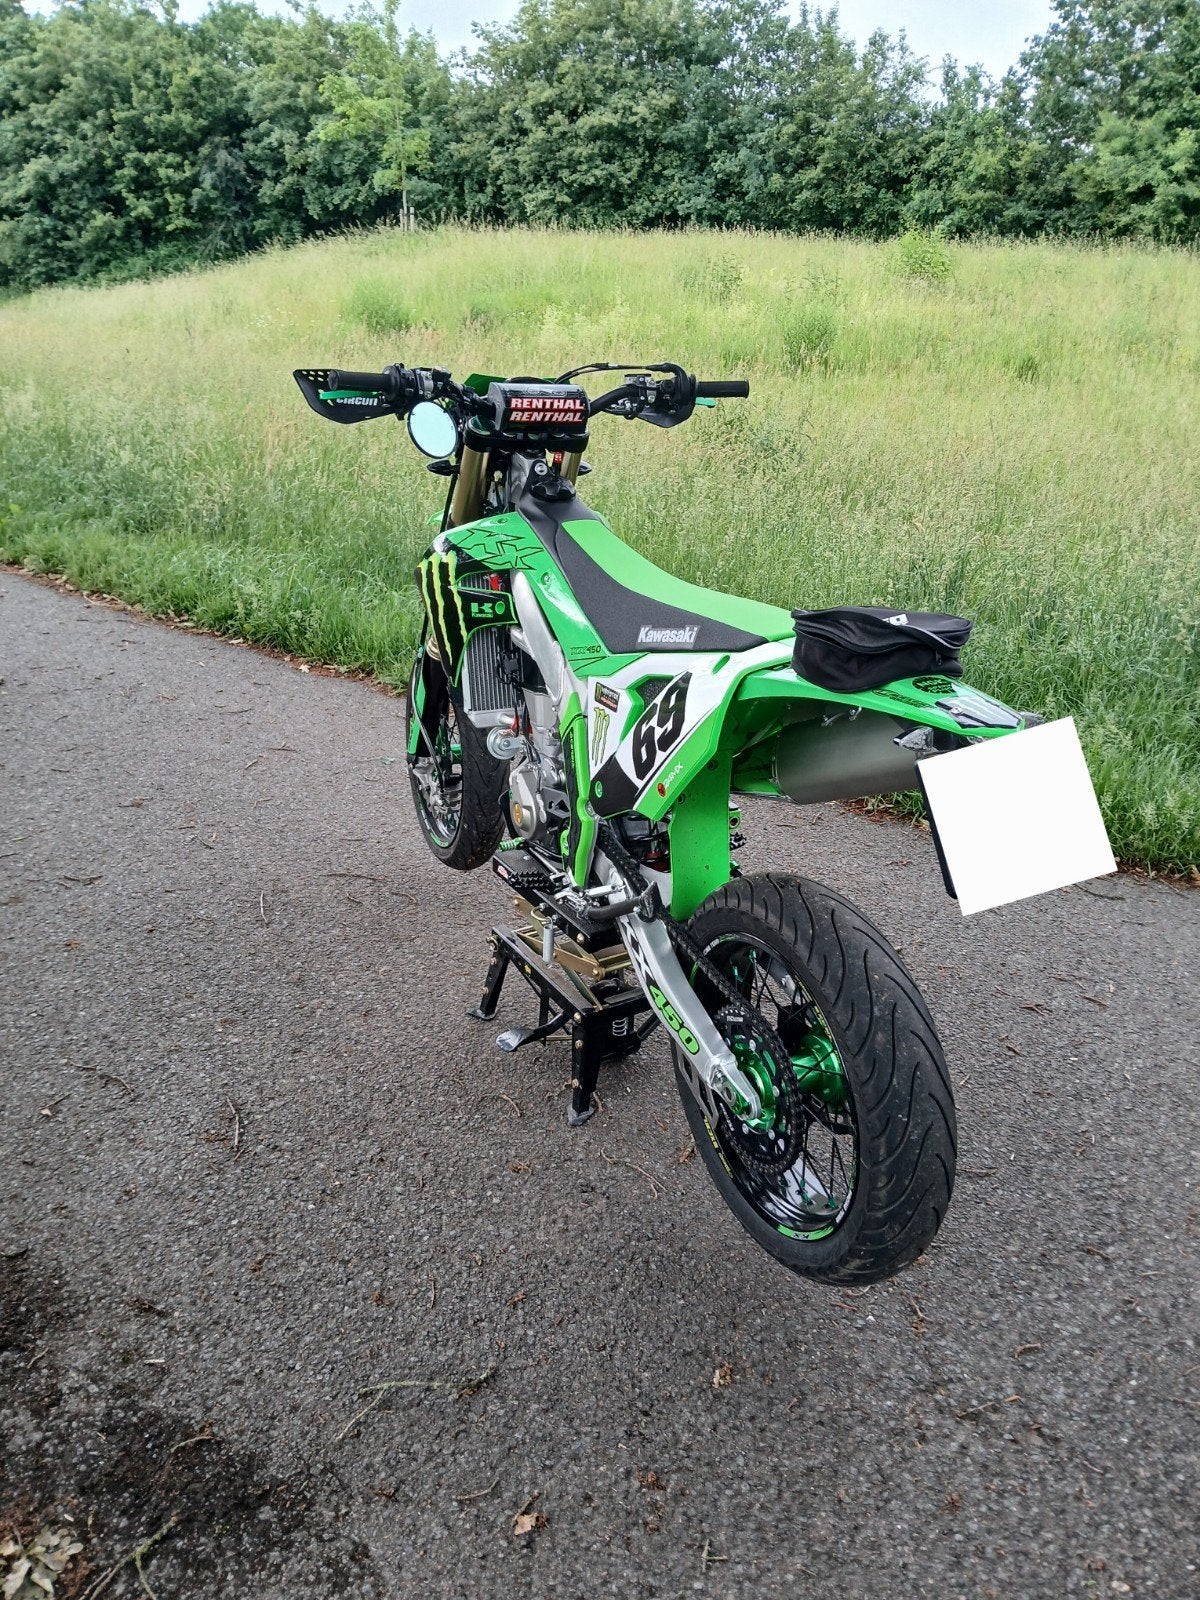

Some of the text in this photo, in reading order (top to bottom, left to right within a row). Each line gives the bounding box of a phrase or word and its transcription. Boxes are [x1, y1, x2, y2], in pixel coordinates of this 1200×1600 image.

[510, 397, 584, 410] RENTHAL
[509, 411, 583, 422] RENTHAL
[637, 627, 697, 643] Kawasaki
[632, 671, 692, 781] 69
